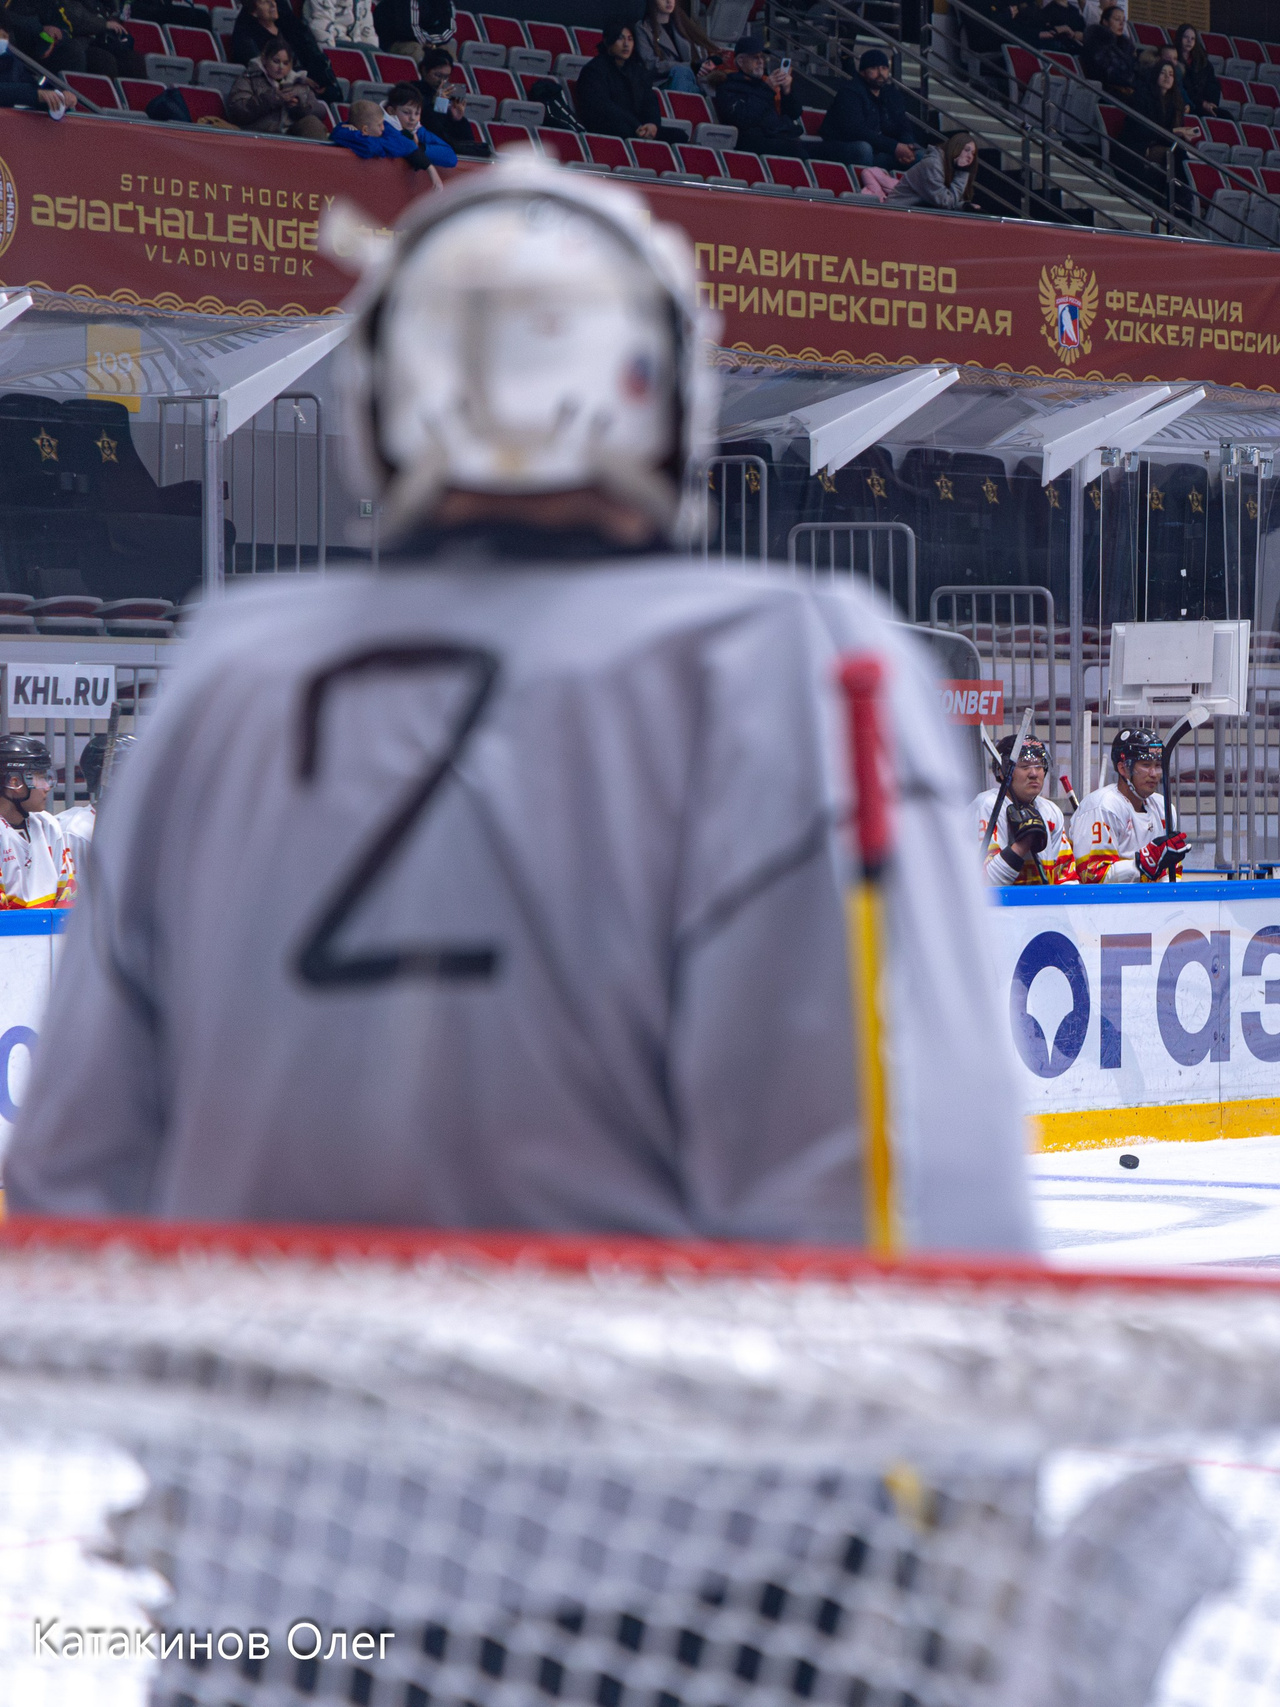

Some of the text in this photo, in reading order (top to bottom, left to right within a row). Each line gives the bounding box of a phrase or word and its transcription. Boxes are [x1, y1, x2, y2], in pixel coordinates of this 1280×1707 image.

[120, 174, 335, 213] STUDENT HOCKEY
[145, 243, 313, 277] VLADIVOSTOK
[694, 241, 957, 294] ПРАВИТЕЛЬСТВО
[695, 281, 1013, 337] ПРИМОРСКОГО КРАЯ
[1105, 289, 1243, 324] ФЕДЕРАЦИЯ
[1104, 318, 1195, 348] ХОККЕЯ
[94, 351, 133, 376] 109
[13, 676, 110, 706] KHL.RU
[295, 641, 502, 988] 2
